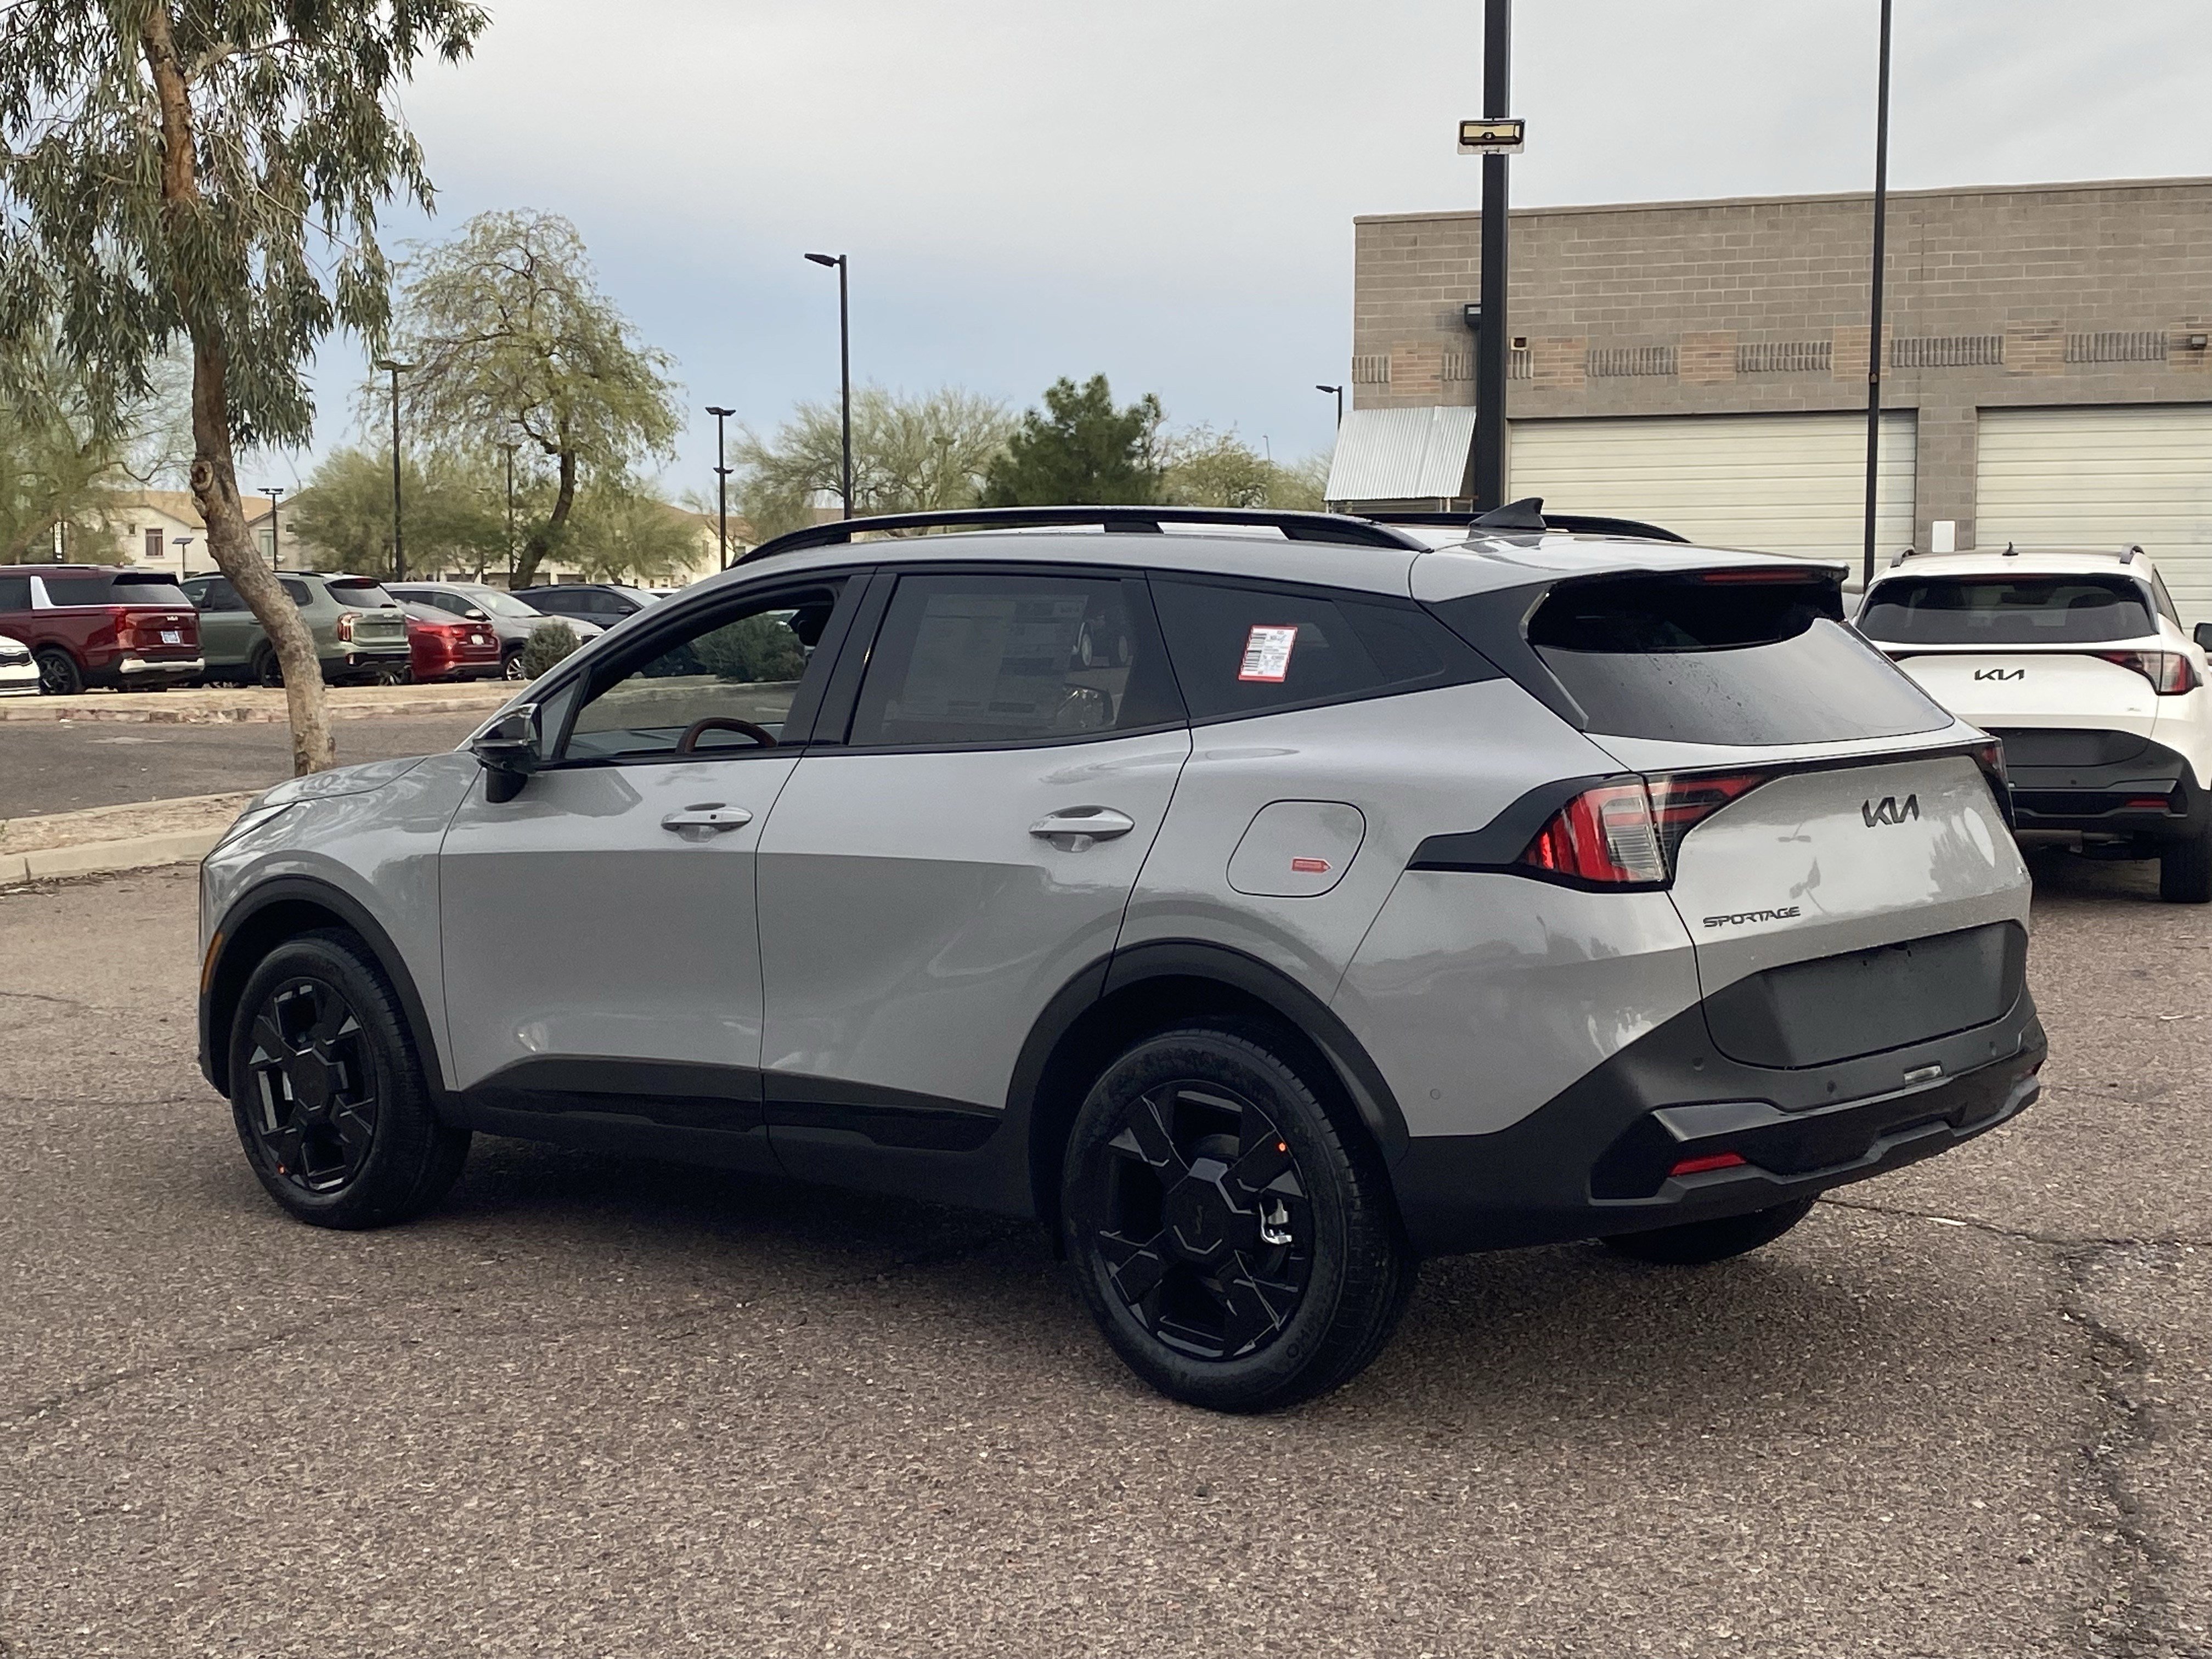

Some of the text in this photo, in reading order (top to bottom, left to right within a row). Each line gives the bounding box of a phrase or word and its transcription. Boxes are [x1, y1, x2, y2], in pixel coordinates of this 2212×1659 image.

[1974, 669, 2024, 680] KIA
[1862, 794, 1919, 828] KIA
[1703, 906, 1801, 928] SPORTAGE
